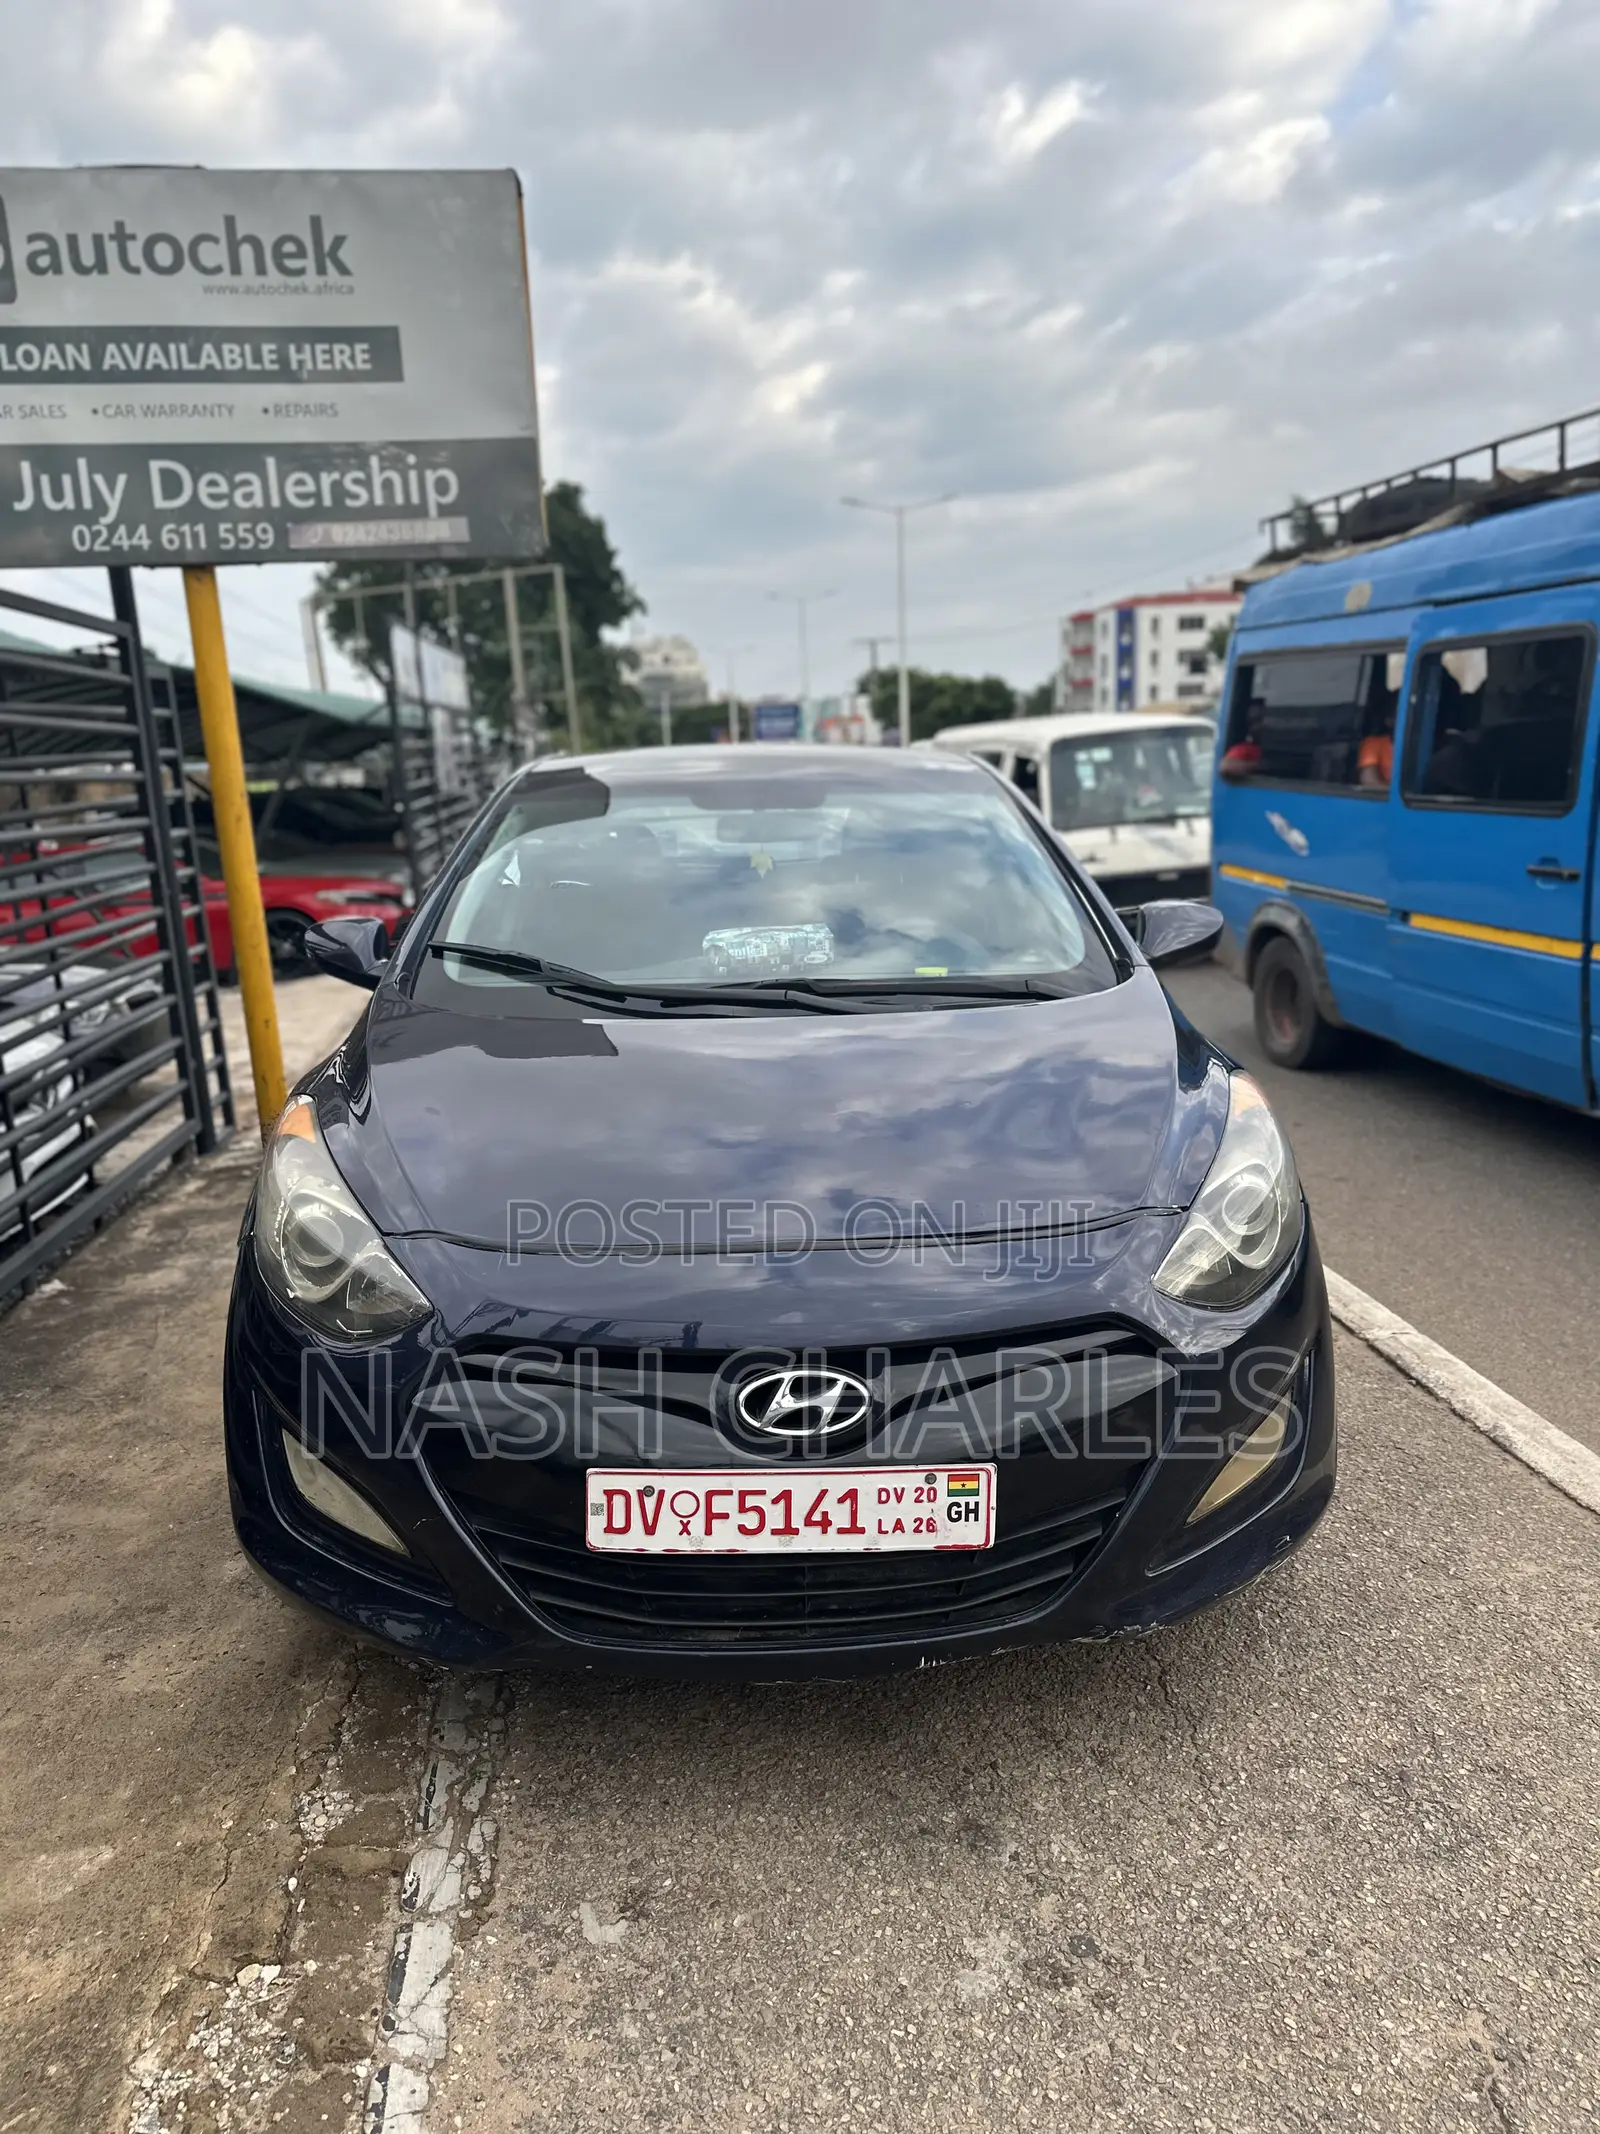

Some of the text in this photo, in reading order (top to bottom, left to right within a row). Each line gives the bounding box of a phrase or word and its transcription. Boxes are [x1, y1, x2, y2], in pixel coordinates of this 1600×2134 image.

[25, 215, 353, 277] autochek
[201, 280, 355, 297] www.autochek.africa
[0, 342, 372, 372] LOAN AVAILABLE HERE
[18, 403, 67, 419] SALES
[102, 403, 235, 419] CAR WARRANTY
[273, 402, 339, 419] REPAIRS
[13, 453, 459, 525] July Dealership
[72, 522, 275, 552] 0244 611 559
[877, 1486, 938, 1504] DV 20
[603, 1488, 666, 1536] DV
[704, 1488, 866, 1536] F5141
[946, 1501, 980, 1523] GH
[877, 1516, 937, 1534] LA 26
